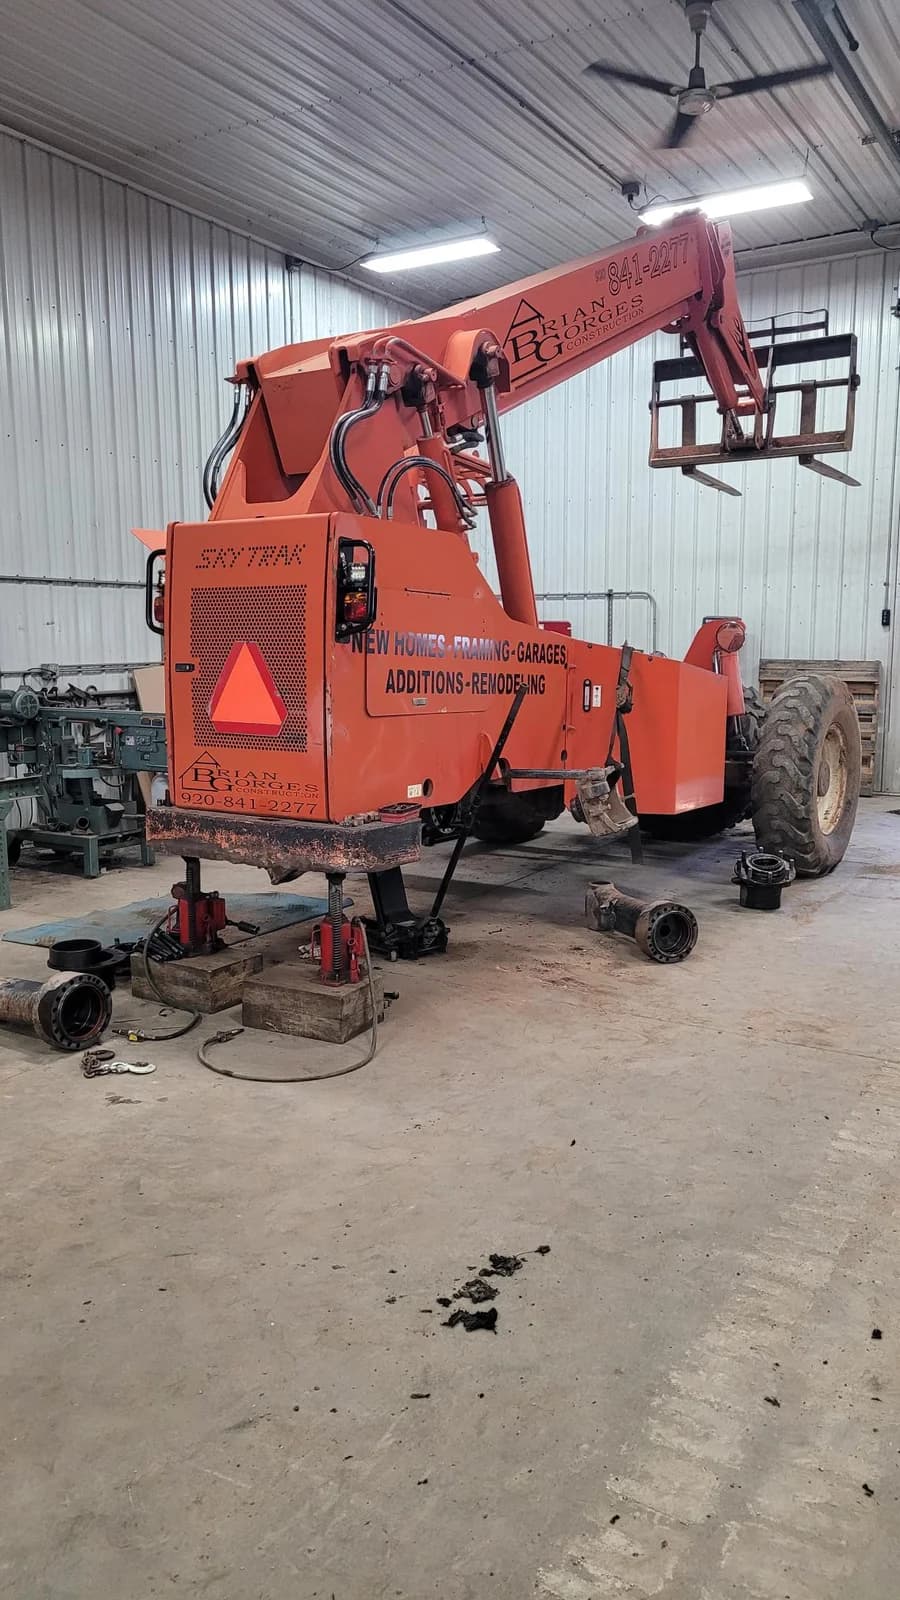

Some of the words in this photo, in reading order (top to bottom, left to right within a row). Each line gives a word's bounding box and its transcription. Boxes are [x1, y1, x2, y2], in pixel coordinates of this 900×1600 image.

[608, 233, 688, 295] 841-2277
[535, 295, 643, 362] GORGES
[566, 308, 644, 350] CONSTRUCTION
[351, 629, 389, 655] NEW
[210, 777, 319, 792] GORGES
[235, 787, 319, 799] CONSTRUCTION
[181, 792, 318, 815] 920-841-2277
